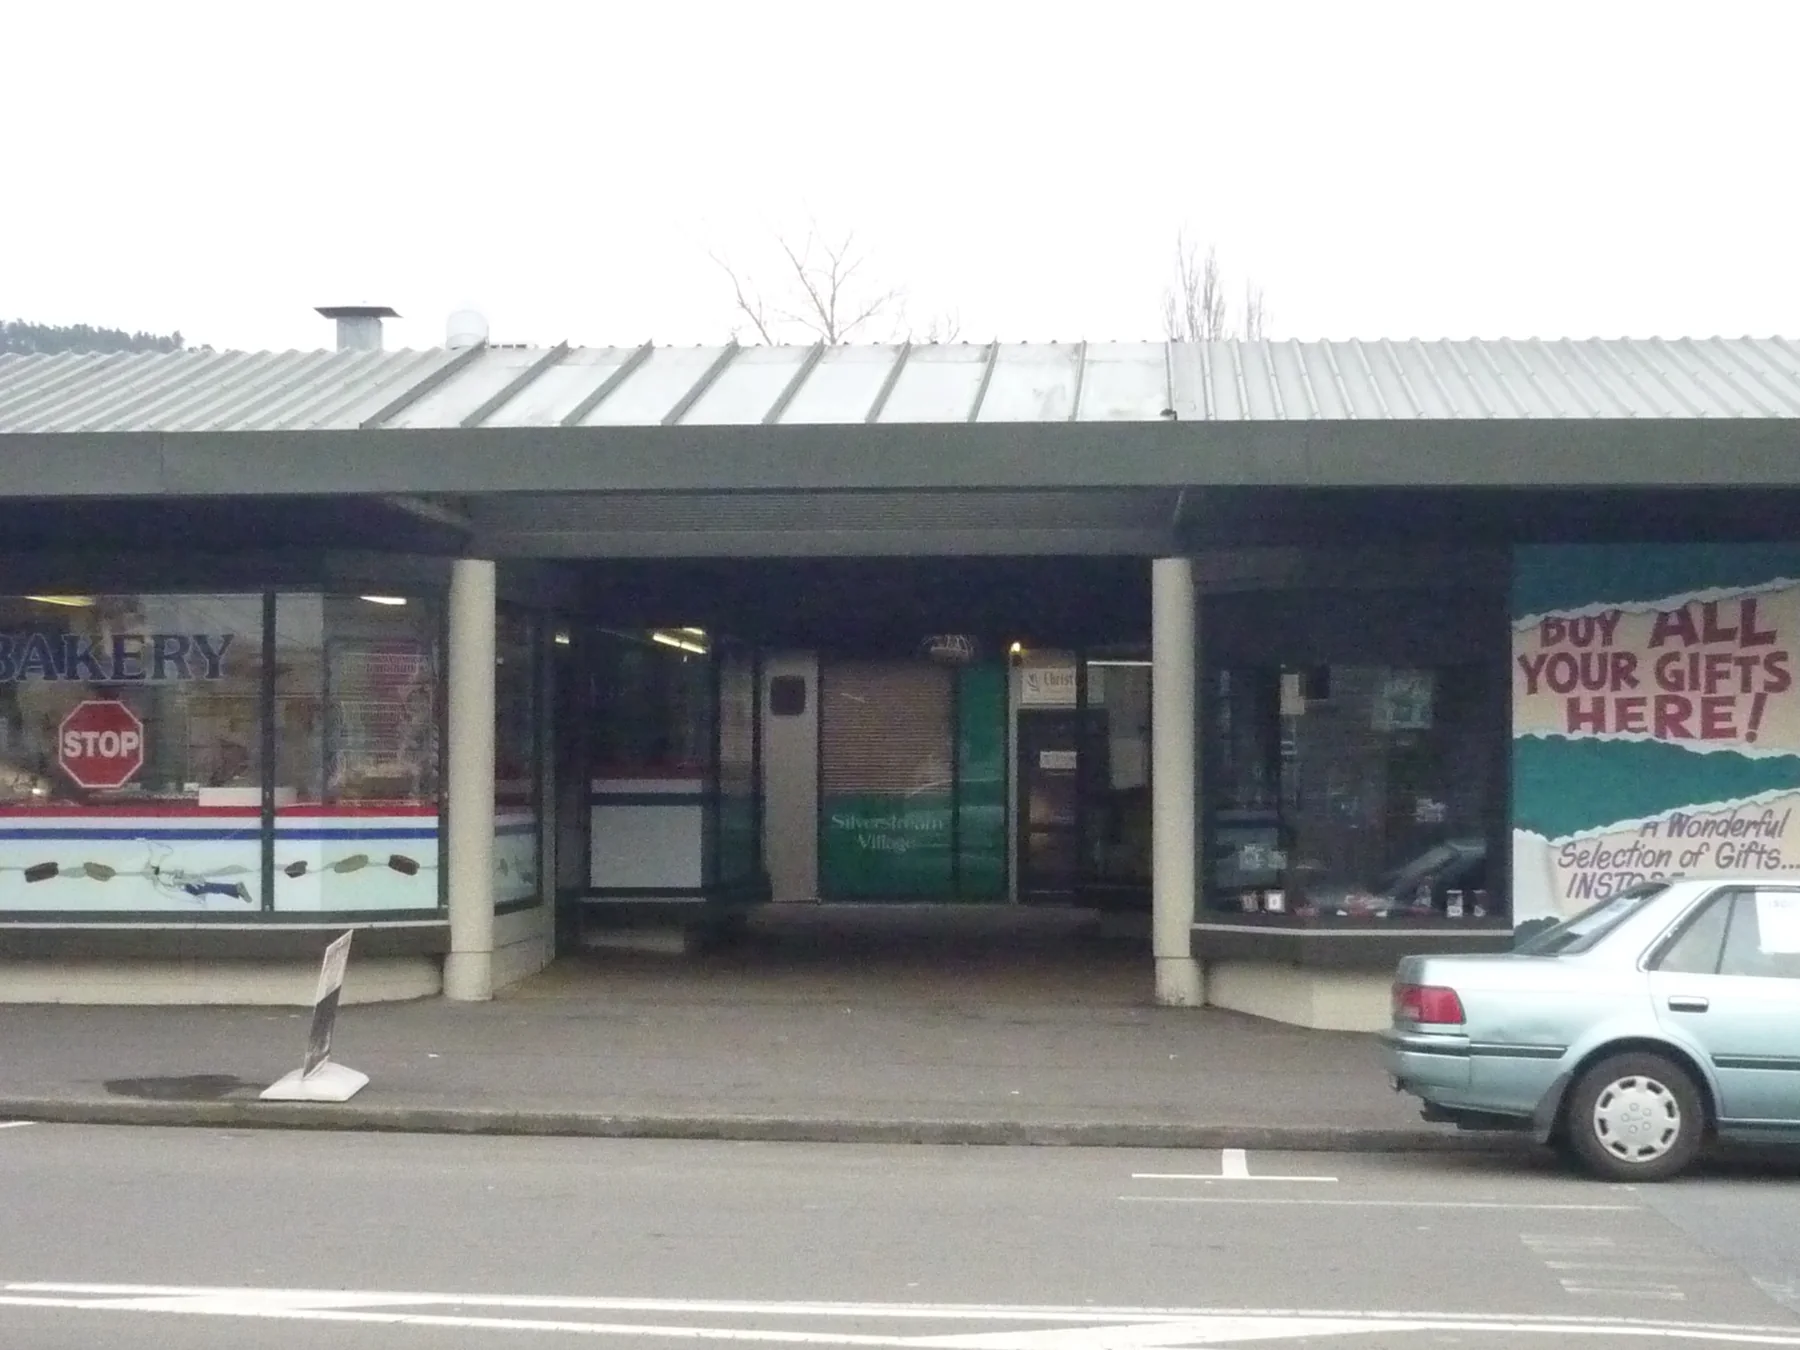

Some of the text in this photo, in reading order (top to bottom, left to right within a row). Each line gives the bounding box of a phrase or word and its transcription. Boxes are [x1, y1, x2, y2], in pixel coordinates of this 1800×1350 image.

[1542, 598, 1778, 648] BUY ALL
[1517, 650, 1792, 695] YOUR GIFTS
[1567, 693, 1767, 743] HERE!
[64, 730, 139, 758] STOP
[1641, 809, 1790, 839] A Wonderful
[1558, 840, 1672, 870] Selection
[1678, 841, 1711, 869] of
[1566, 872, 1685, 900] INST
